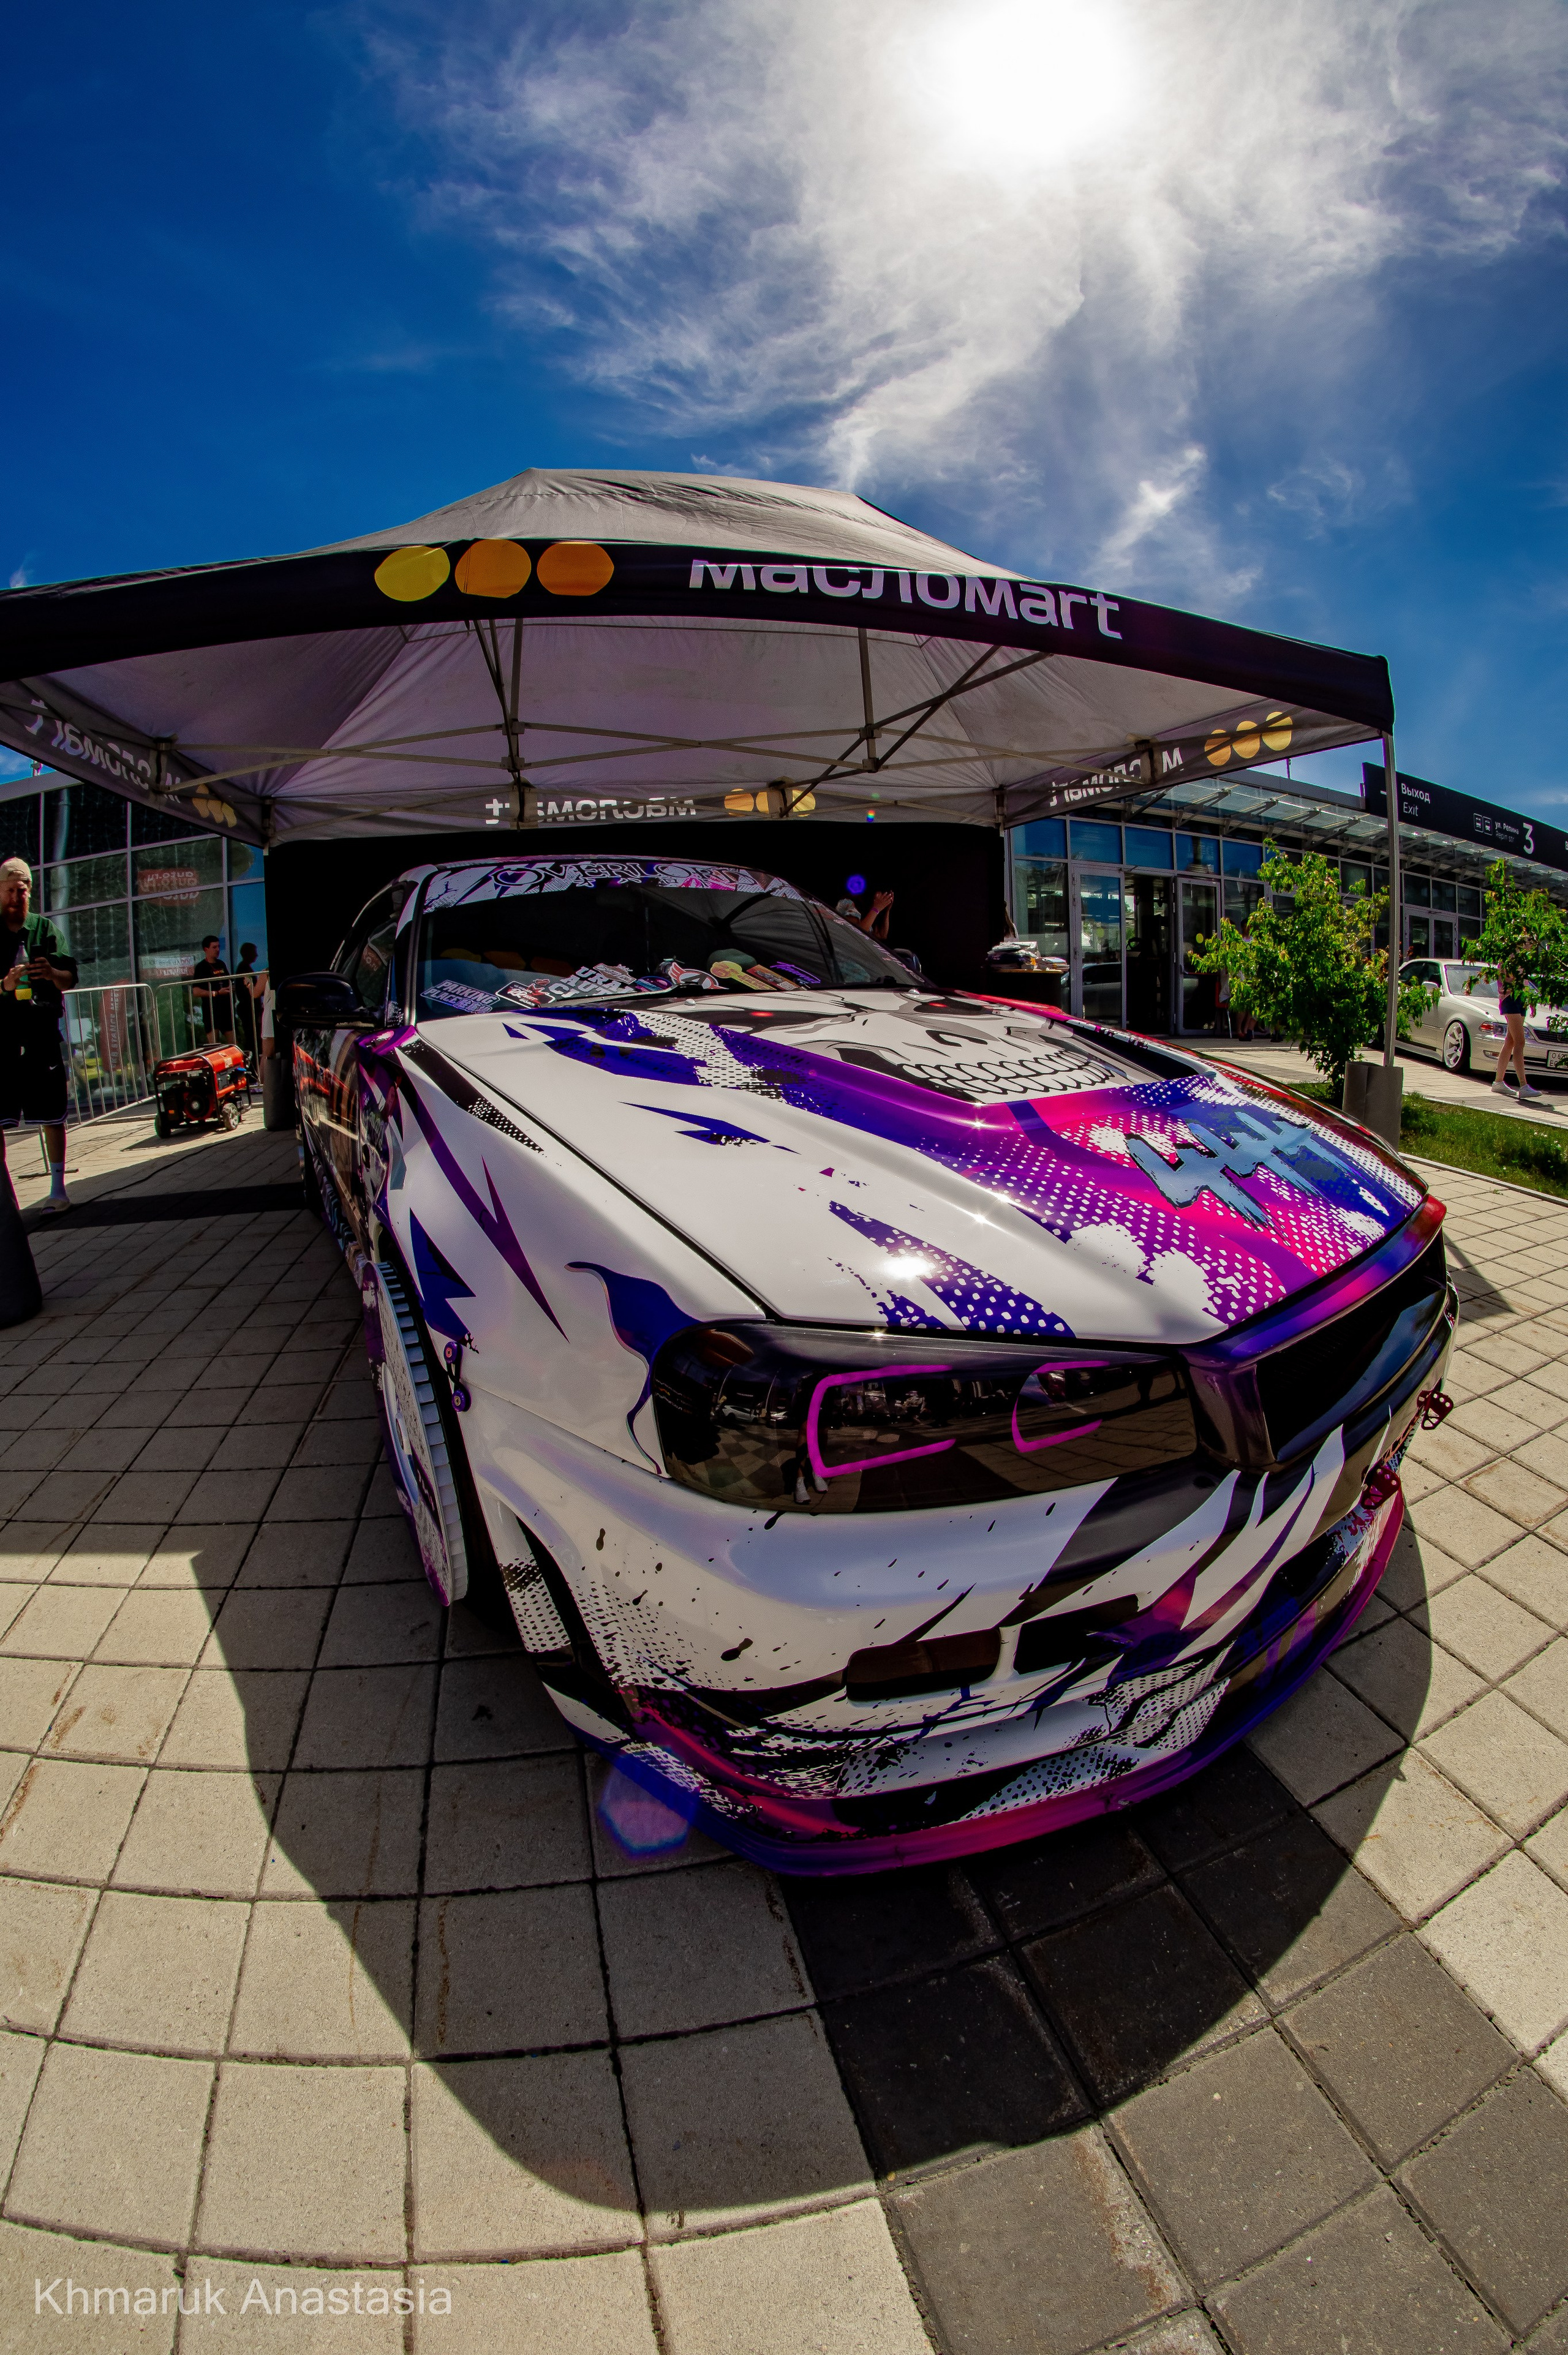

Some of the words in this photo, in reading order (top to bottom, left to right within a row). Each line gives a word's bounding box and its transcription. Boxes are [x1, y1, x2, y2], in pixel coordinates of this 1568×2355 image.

[1401, 783, 1431, 804] Выход
[1403, 802, 1419, 817] Exit
[1523, 822, 1534, 854] 3
[424, 988, 462, 1004] PLACE
[437, 980, 497, 1004] PARKING
